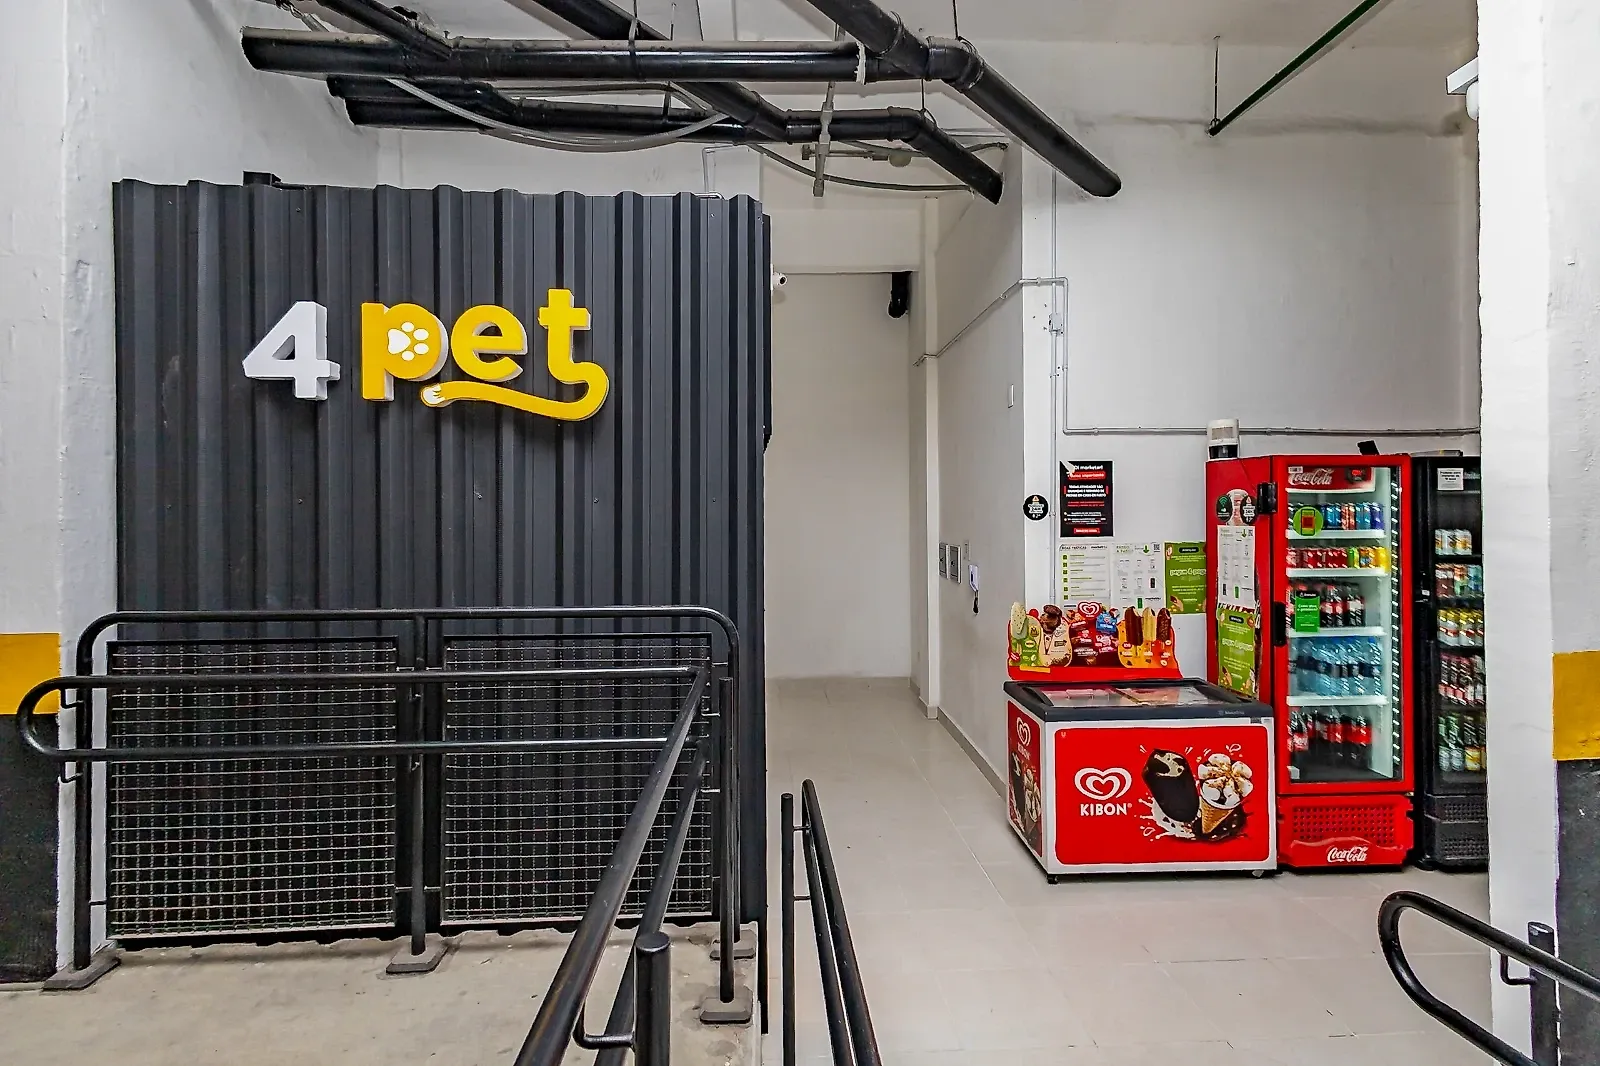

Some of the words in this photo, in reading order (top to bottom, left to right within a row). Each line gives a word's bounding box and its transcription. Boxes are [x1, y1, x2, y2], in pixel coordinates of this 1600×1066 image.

[242, 301, 341, 401] 4
[361, 288, 610, 421] pet
[1327, 846, 1369, 863] Coca-Cola
